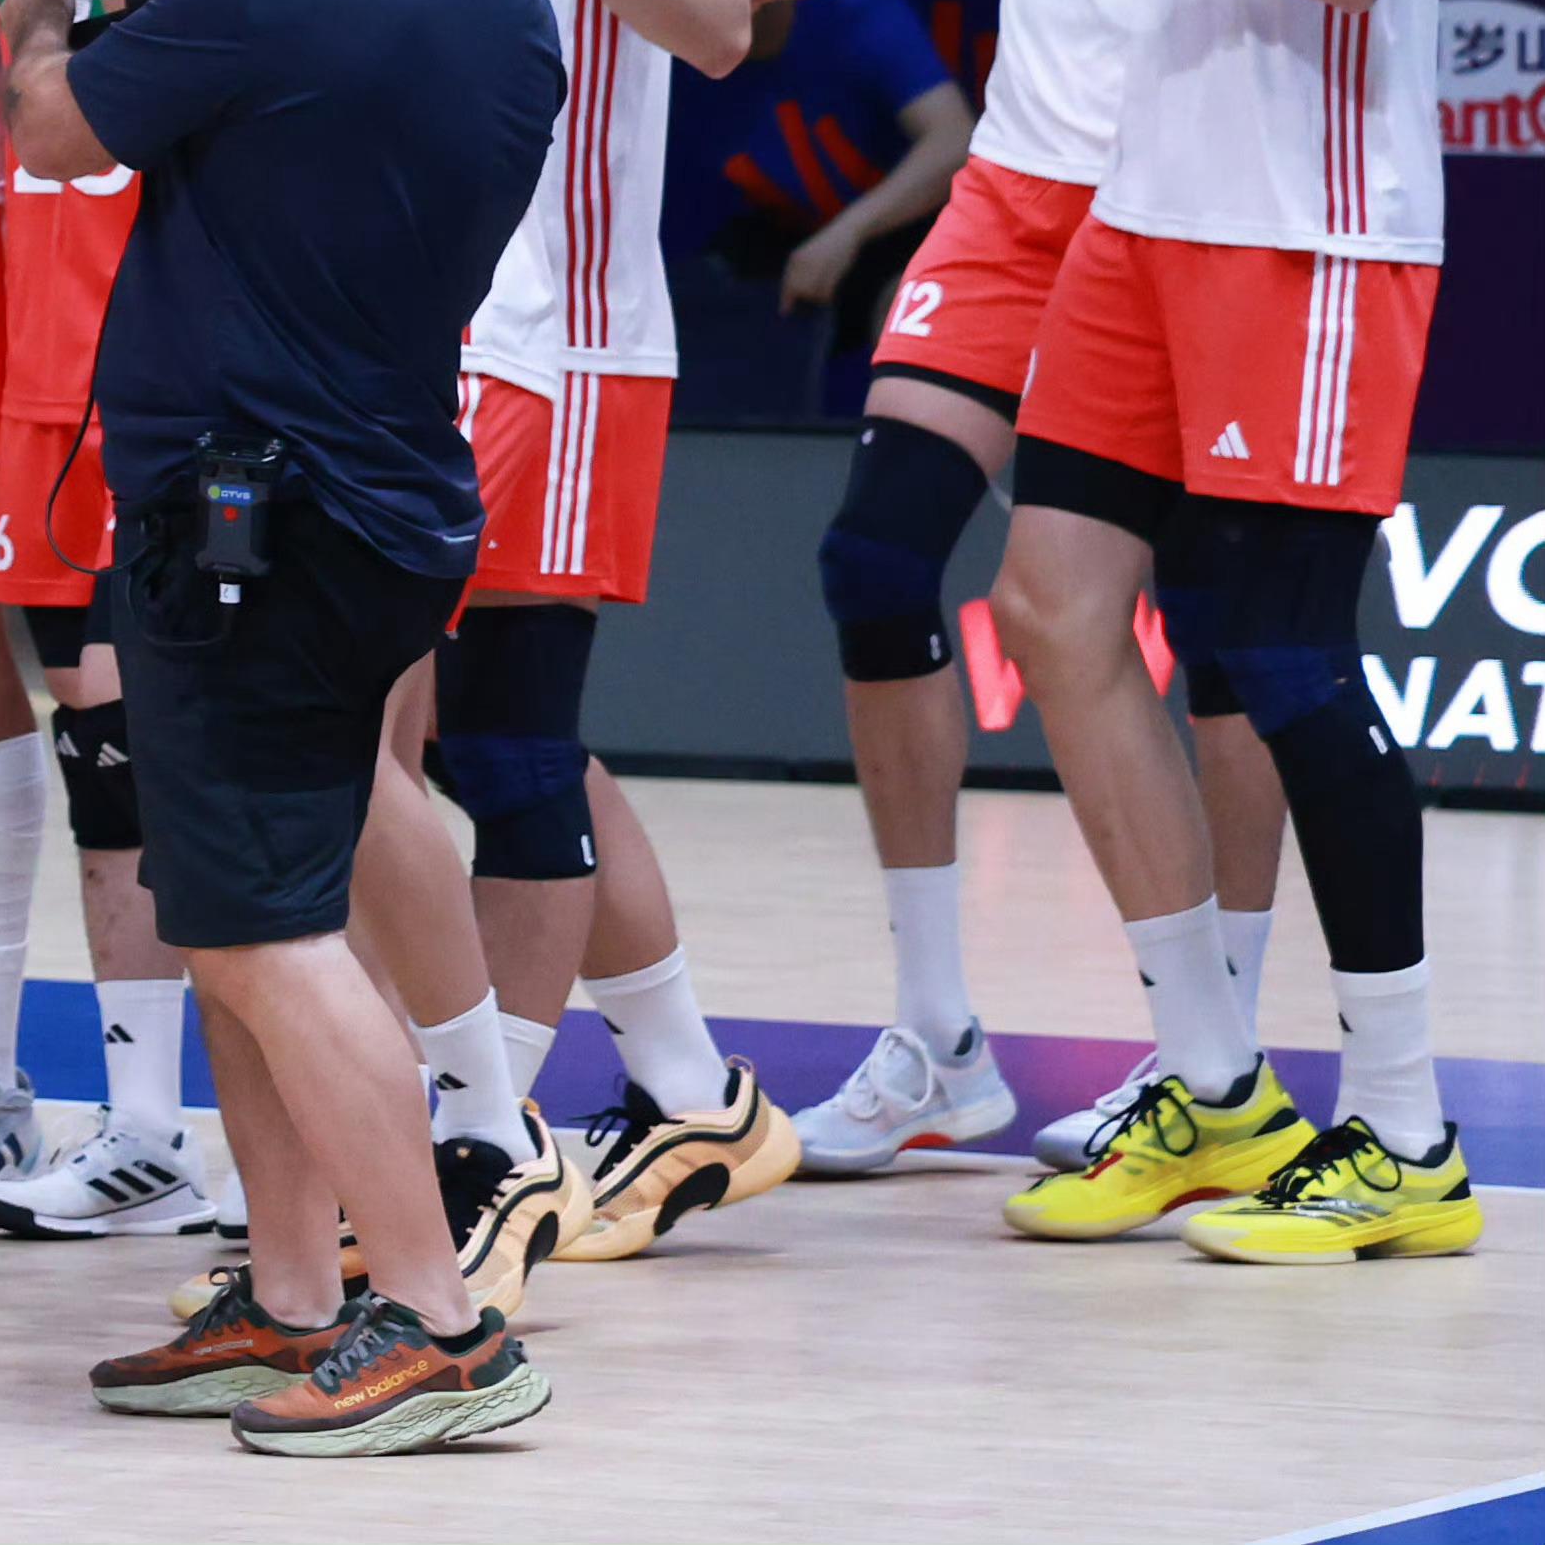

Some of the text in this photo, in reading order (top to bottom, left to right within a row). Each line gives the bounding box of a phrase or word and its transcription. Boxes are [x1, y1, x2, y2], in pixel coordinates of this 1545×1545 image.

[889, 279, 943, 337] 12
[333, 1358, 429, 1411] new balance
